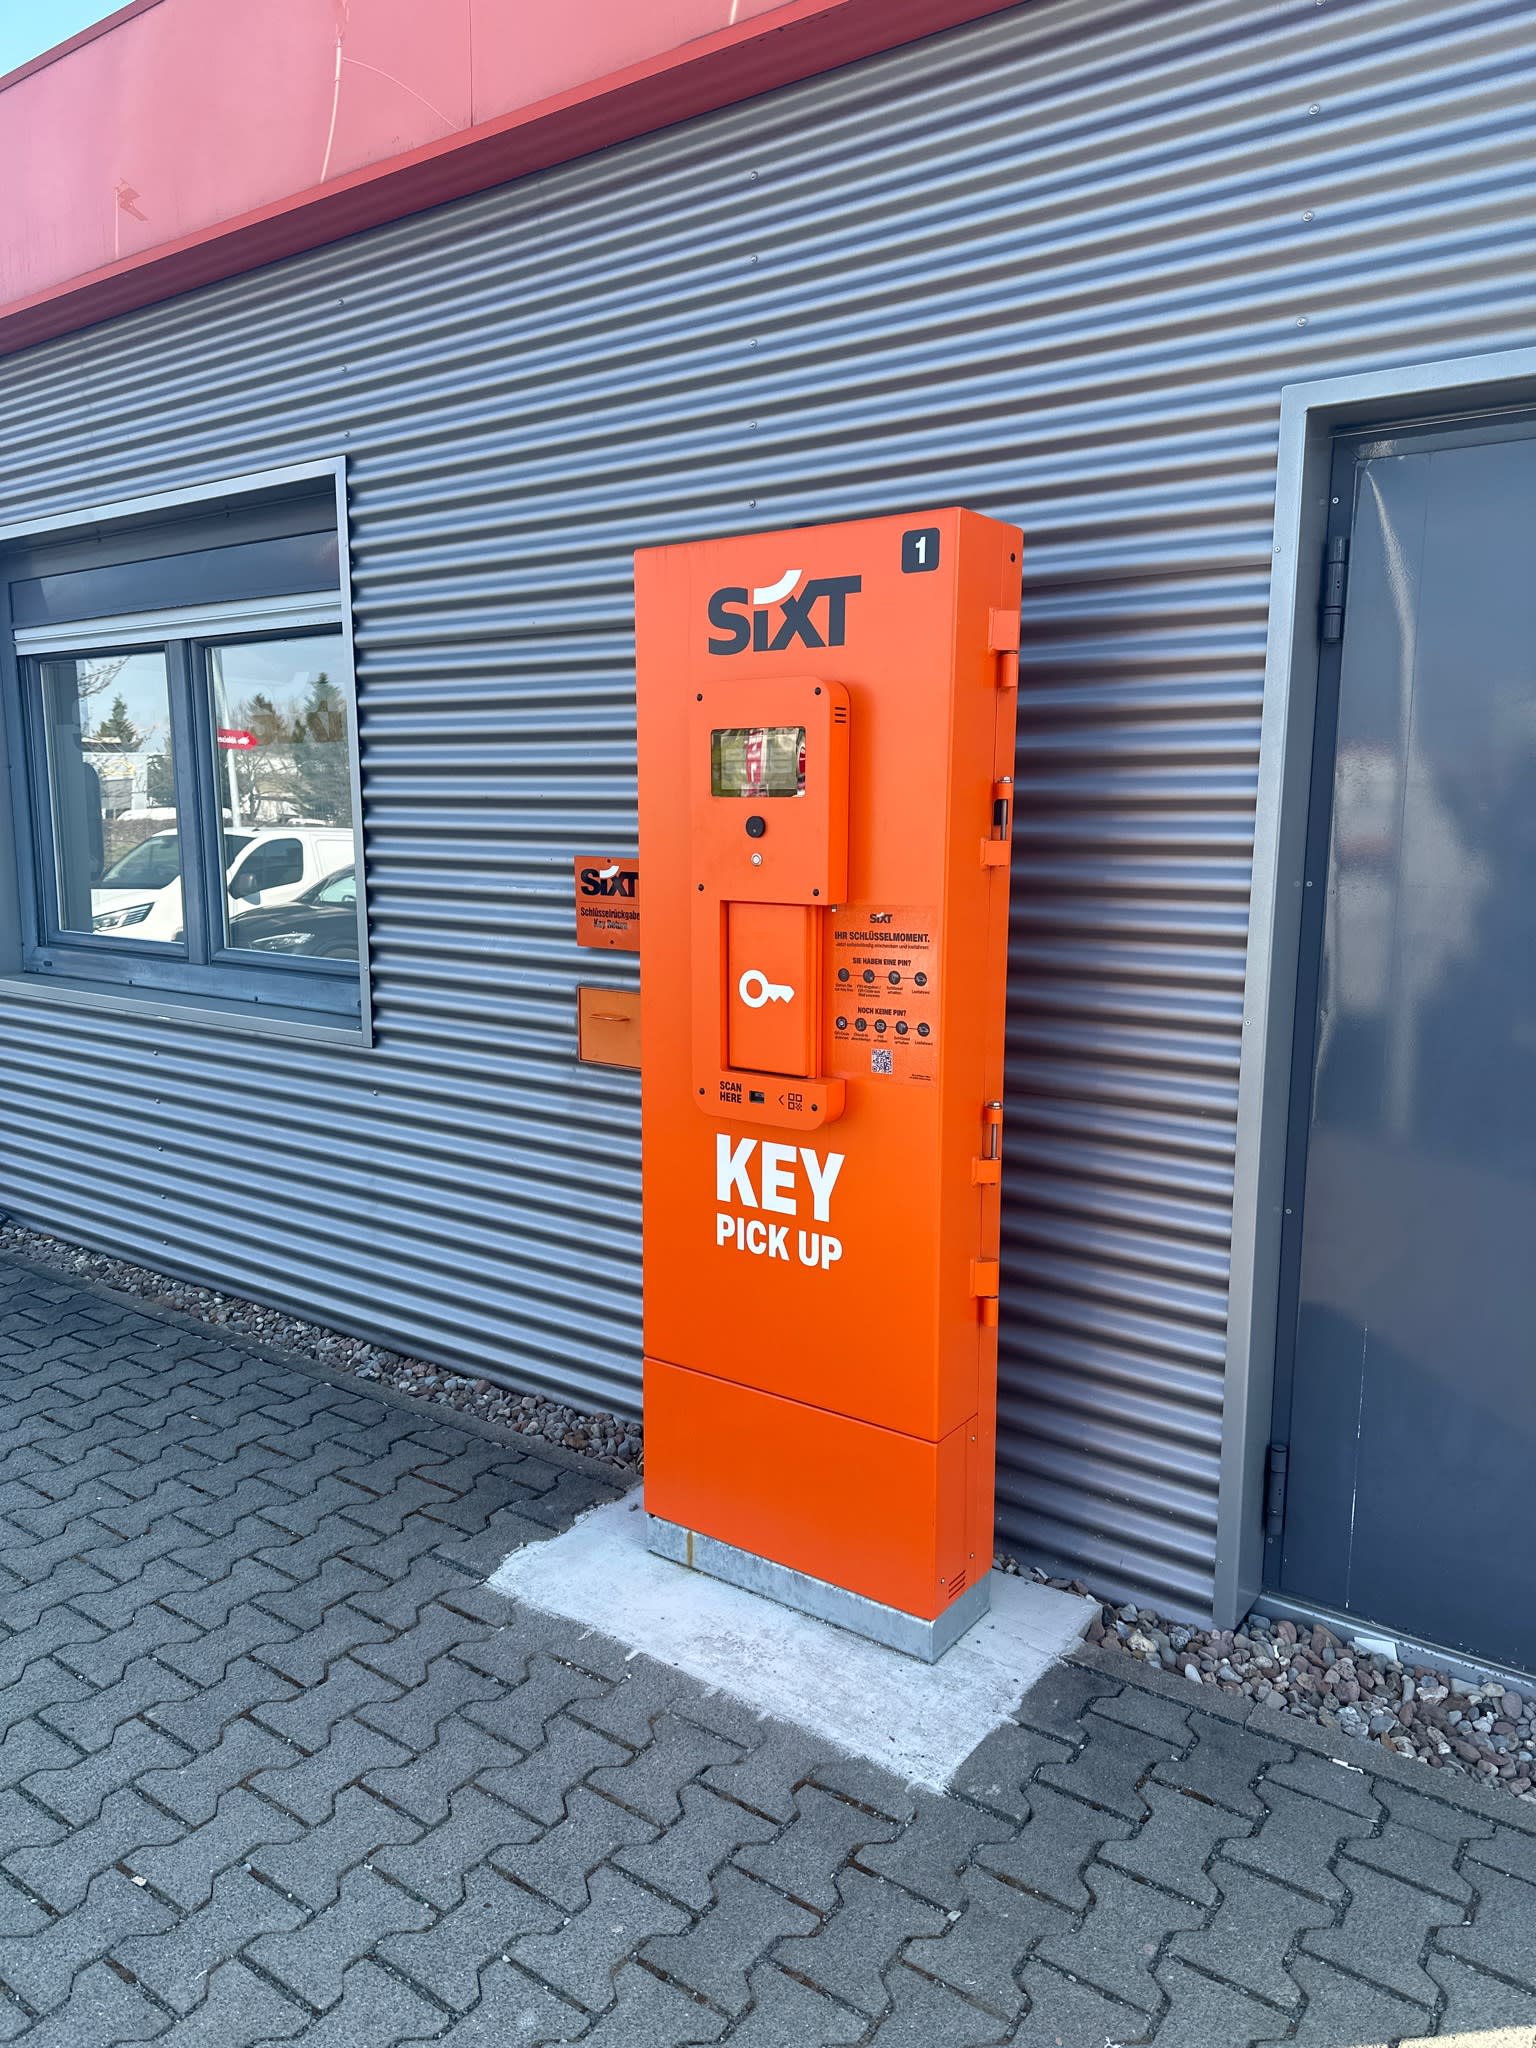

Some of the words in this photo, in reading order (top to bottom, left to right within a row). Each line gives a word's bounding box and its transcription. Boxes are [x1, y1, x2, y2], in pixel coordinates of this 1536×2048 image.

[914, 535, 927, 564] 1
[707, 569, 862, 656] SIXT
[580, 865, 639, 897] SIXT
[580, 907, 640, 920] Schlüsselrückgabe
[834, 931, 848, 940] IHR
[849, 931, 930, 942] SCHLÜSSELMOMENT.
[862, 957, 882, 965] HABEN
[883, 958, 896, 966] EINE
[897, 959, 912, 967] PIN?
[857, 1006, 874, 1014] NOCH
[875, 1008, 892, 1016] KEINE
[893, 1009, 907, 1017] PIN?
[719, 1080, 742, 1093] SCAN
[719, 1091, 742, 1104] HERE
[716, 1133, 845, 1223] KEY
[716, 1212, 790, 1261] PICK
[798, 1229, 843, 1270] UP
